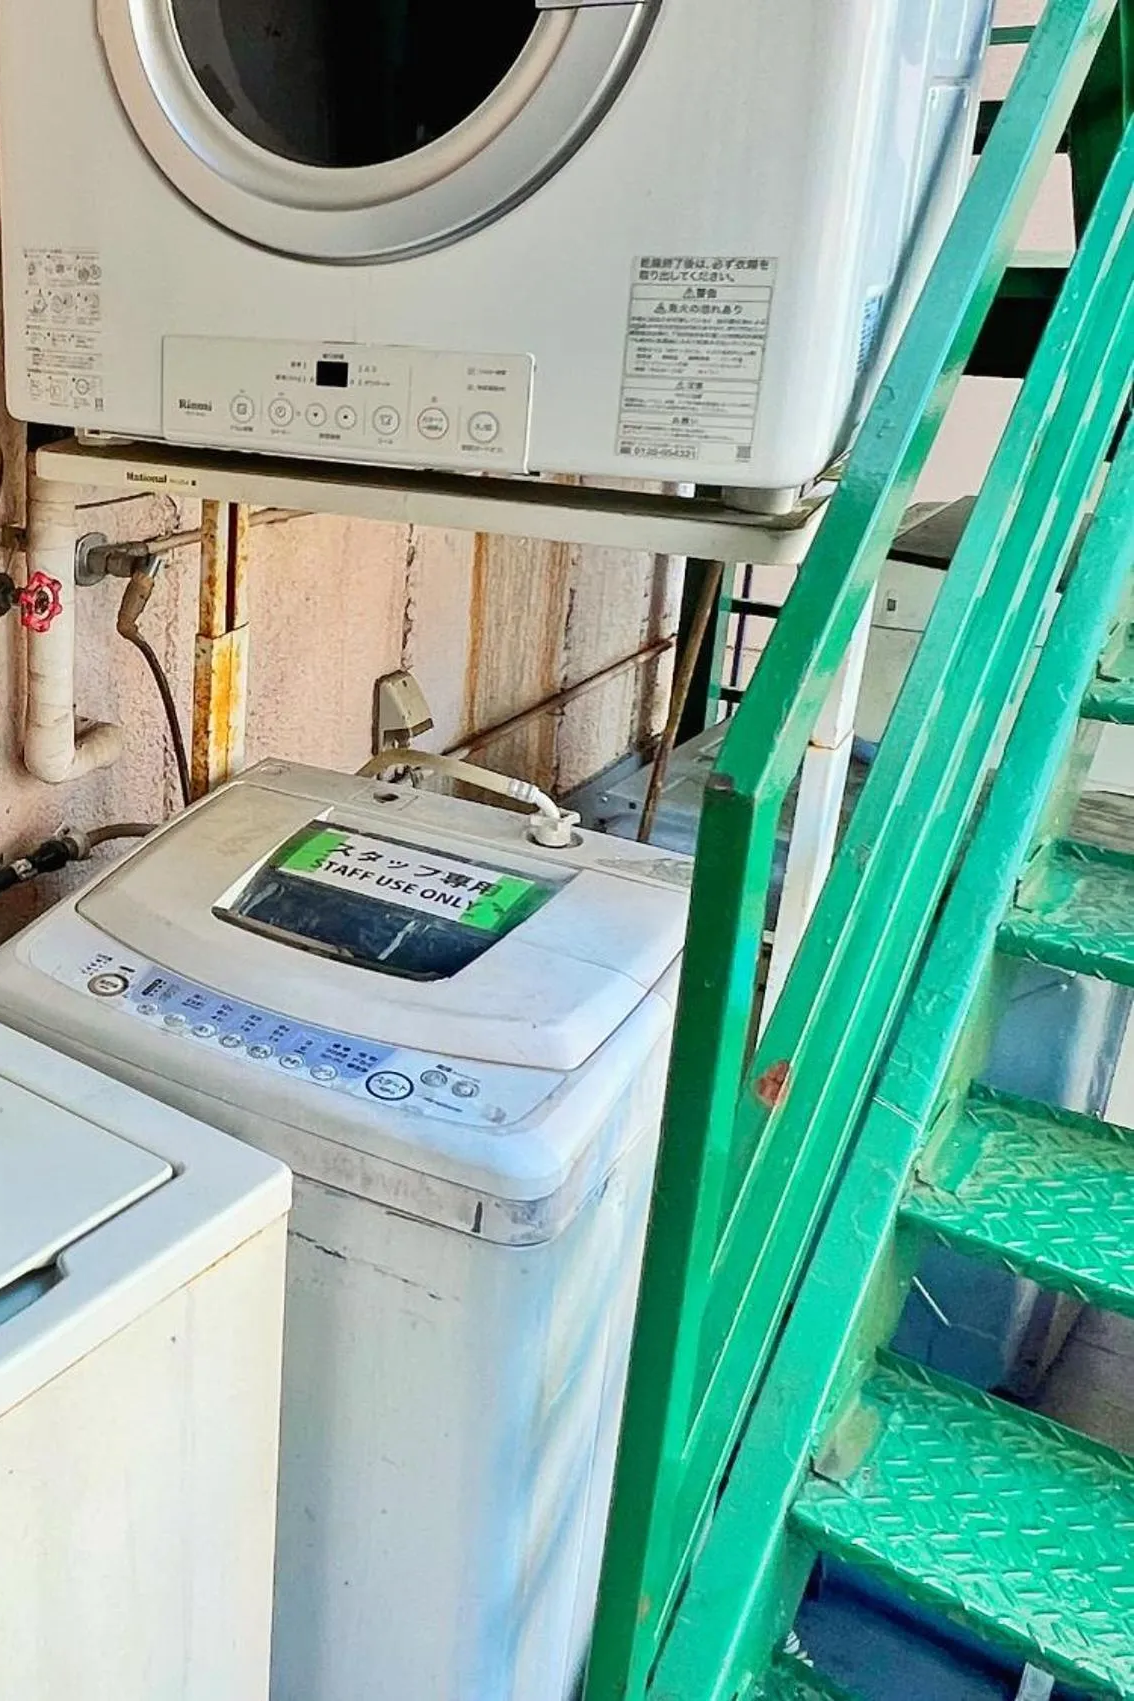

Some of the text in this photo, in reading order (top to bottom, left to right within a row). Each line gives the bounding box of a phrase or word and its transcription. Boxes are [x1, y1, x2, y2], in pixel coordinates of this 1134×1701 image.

[178, 399, 212, 412] Rinnai
[126, 471, 167, 483] National
[311, 856, 481, 912] STAFF USE ONLY
[330, 842, 503, 897] スタッフ専用
